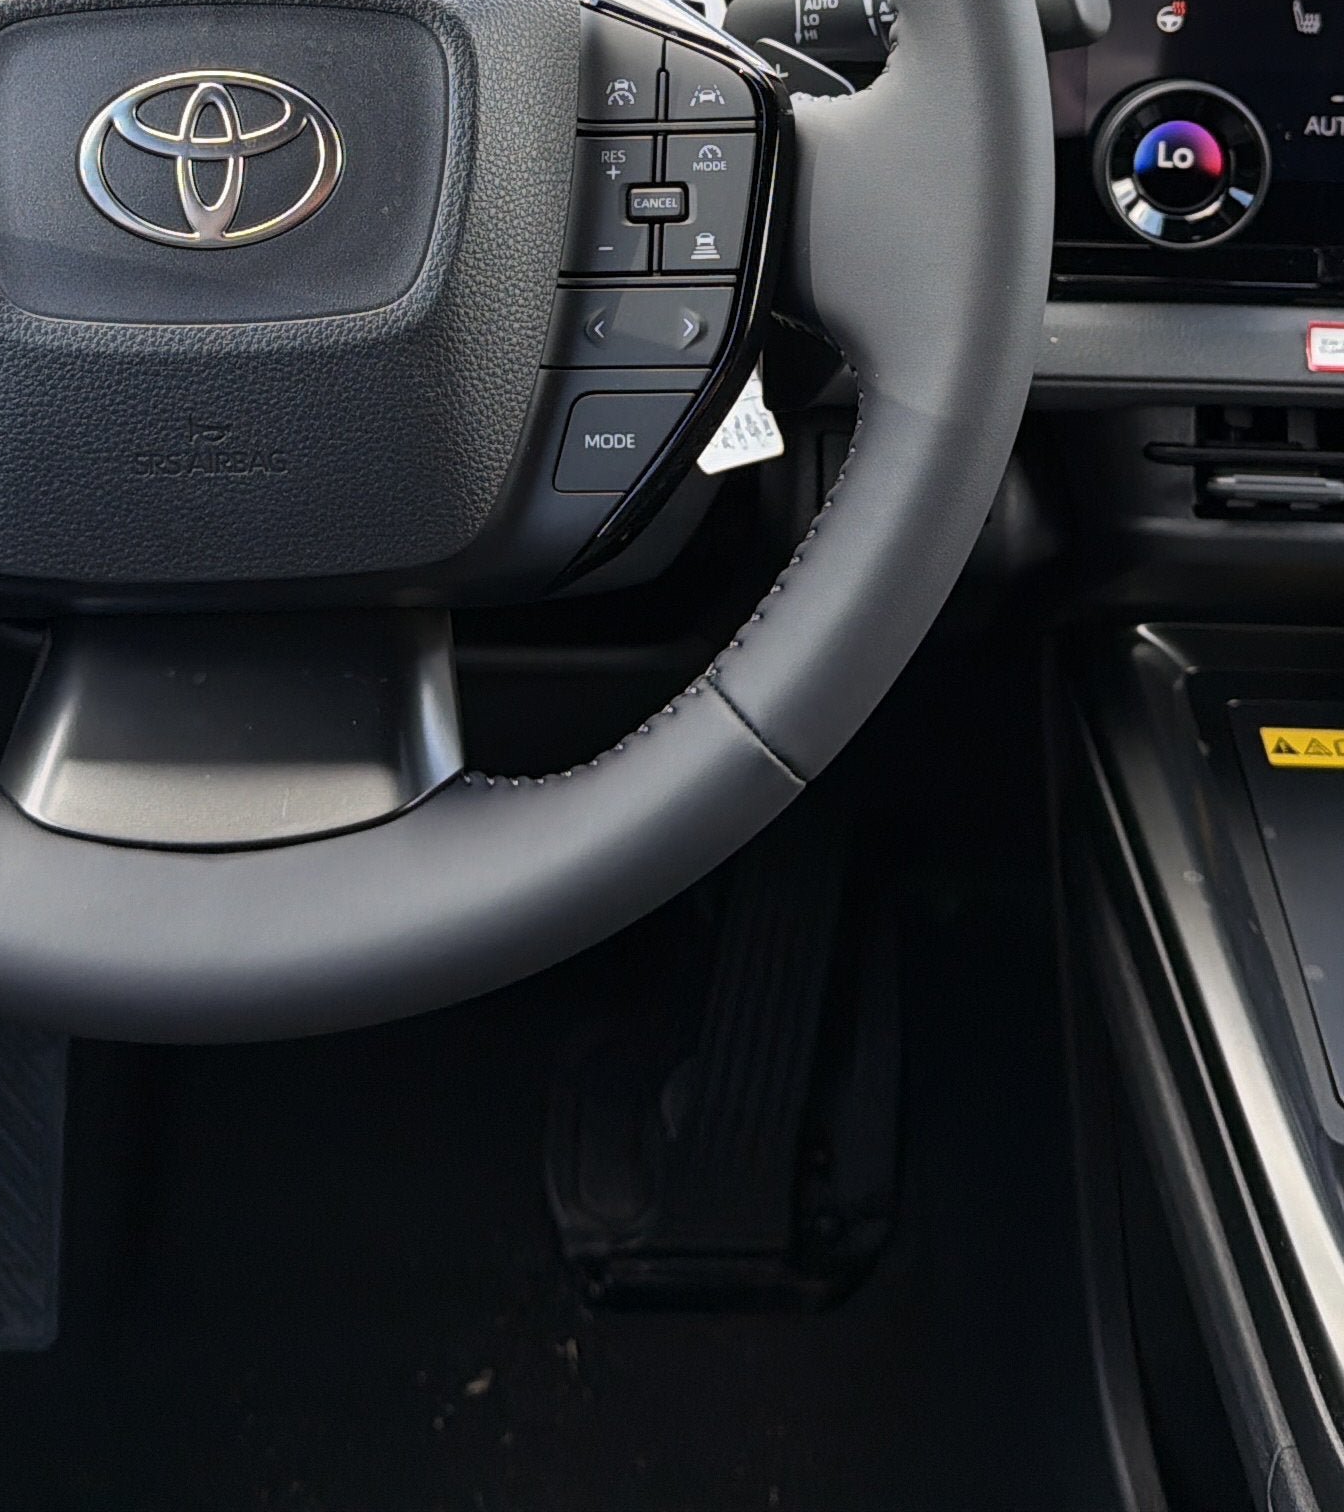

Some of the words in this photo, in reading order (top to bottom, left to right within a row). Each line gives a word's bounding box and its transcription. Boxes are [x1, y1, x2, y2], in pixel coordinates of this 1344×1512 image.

[802, 13, 820, 27] LO
[803, 29, 818, 41] HI
[601, 149, 627, 164] RES
[1156, 142, 1196, 170] Lo
[692, 161, 728, 172] MODE
[633, 197, 679, 209] CANCEL
[584, 432, 637, 450] MODE
